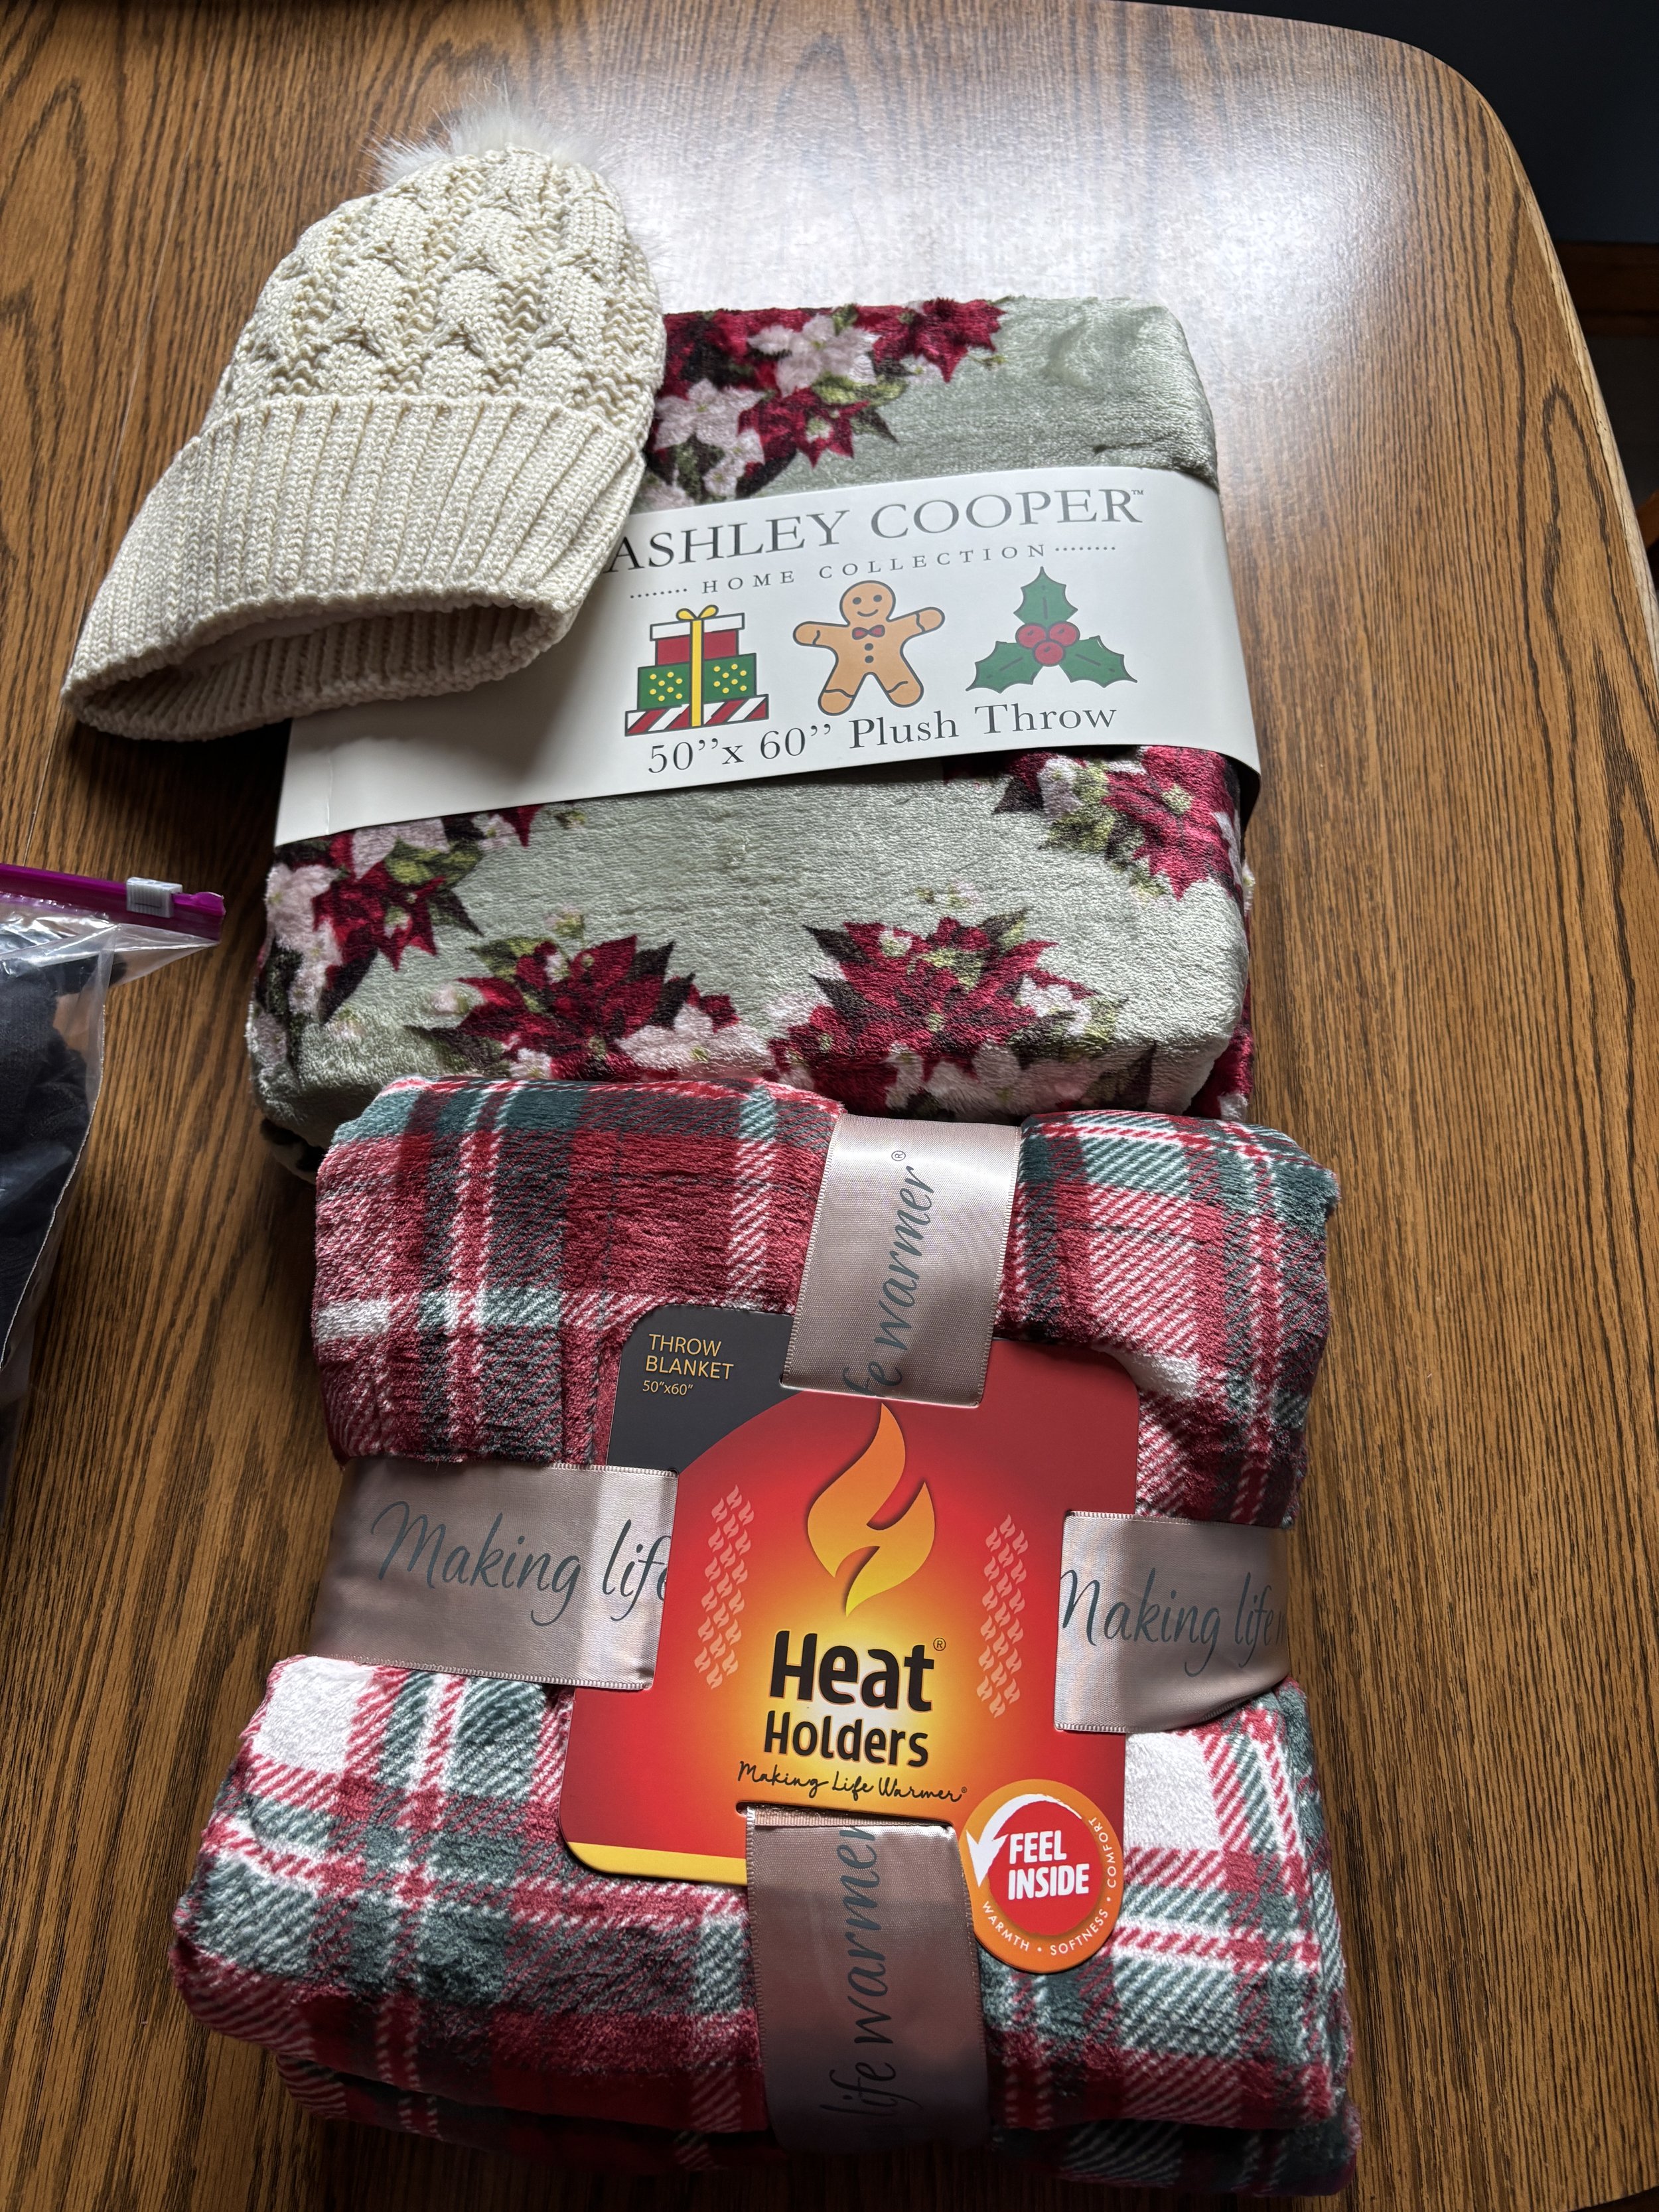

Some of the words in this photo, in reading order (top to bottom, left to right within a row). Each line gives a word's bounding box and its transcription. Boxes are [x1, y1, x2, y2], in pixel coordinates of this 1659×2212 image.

[603, 510, 850, 574] ASHLEY
[701, 570, 795, 595] HOME
[818, 544, 1045, 579] COLLECTION
[849, 710, 960, 749] Plush
[974, 703, 1118, 734] Throw
[645, 1355, 734, 1380] BLANKET
[648, 1333, 722, 1357] THROW
[370, 1501, 582, 1627] Making
[1234, 1572, 1273, 1668] life
[764, 1710, 928, 1767] Holders
[737, 1761, 830, 1799] Making
[831, 1771, 874, 1801] Life
[1009, 1830, 1067, 1864] FEEL
[1088, 1816, 1117, 1889] COMFORT
[1008, 1863, 1090, 1900] INSIDE
[982, 1900, 1031, 1952] WARMTH
[1050, 1908, 1109, 1956] SOFTNESS
[820, 2061, 922, 2117] life
